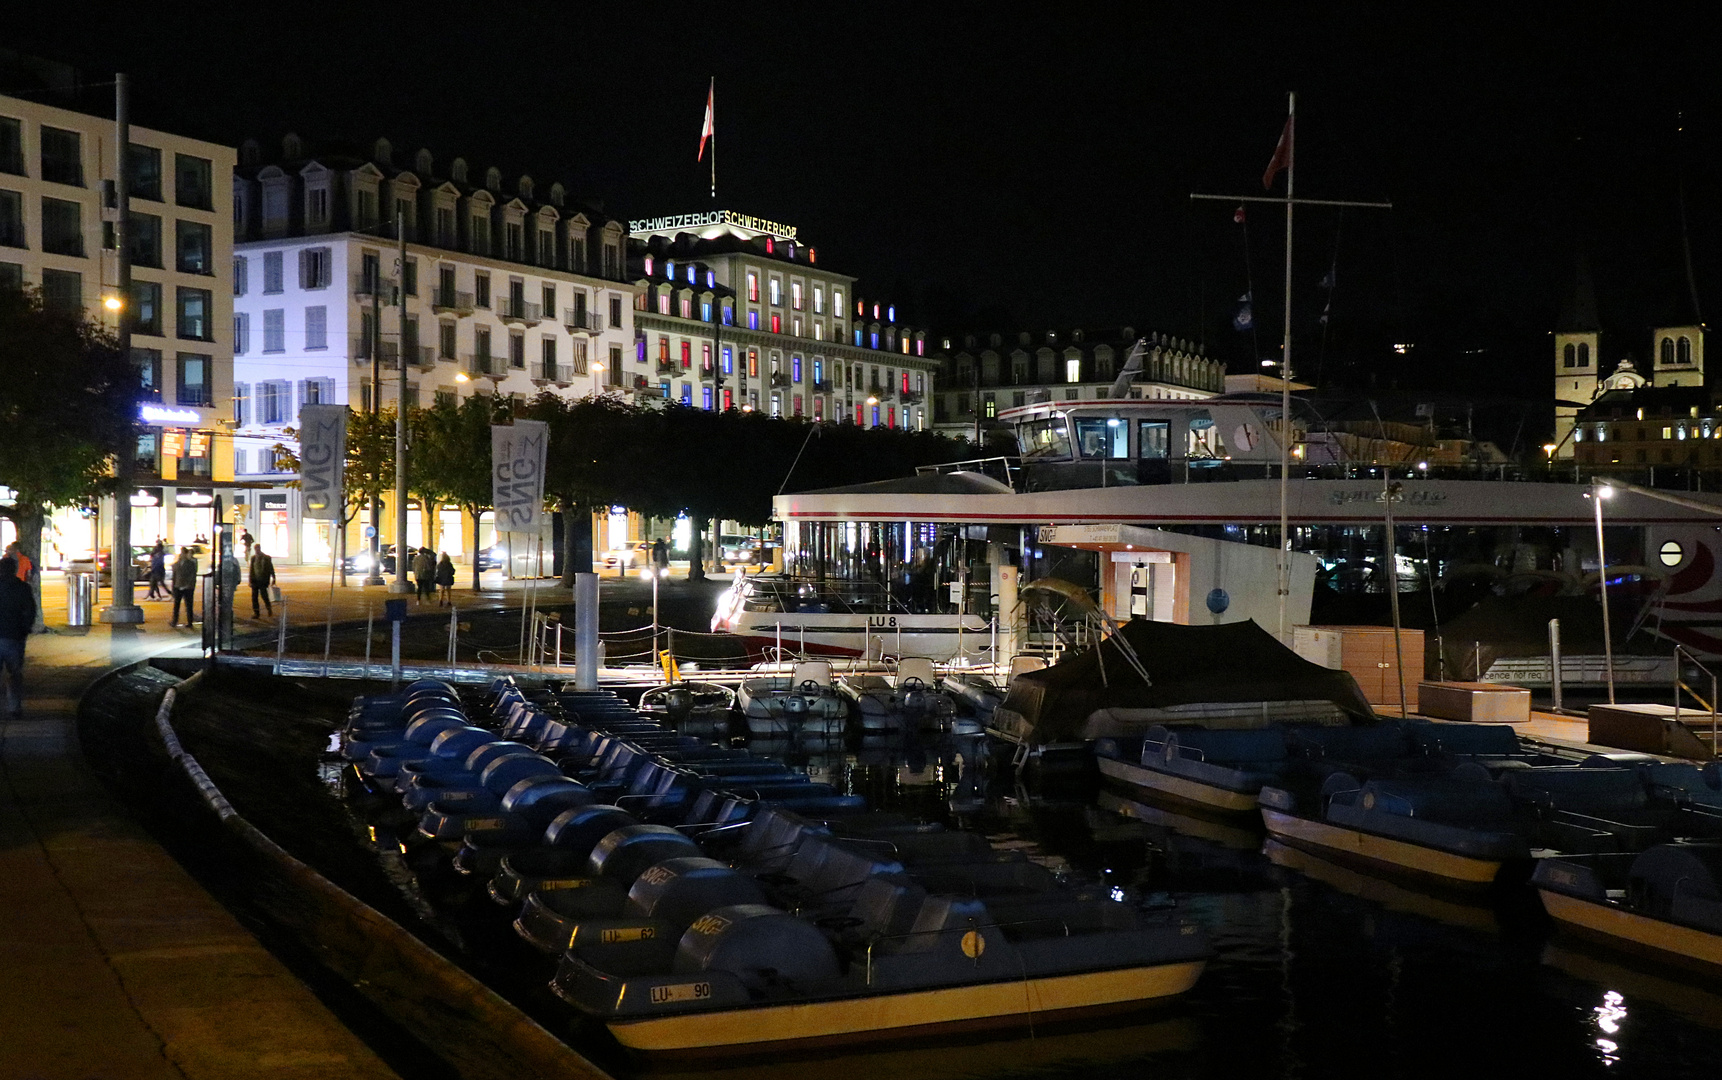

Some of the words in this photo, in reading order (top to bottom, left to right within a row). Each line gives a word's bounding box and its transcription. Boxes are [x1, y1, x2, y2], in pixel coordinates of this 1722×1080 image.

[629, 210, 725, 232] SCHWEIZERHOF
[724, 209, 797, 239] SCHWEIZERHOF
[1040, 529, 1052, 542] SNG
[869, 616, 885, 627] LU
[889, 616, 897, 627] 8
[641, 866, 667, 885] SNG
[692, 915, 720, 935] SNG
[603, 930, 618, 943] LU
[641, 928, 654, 941] 62
[652, 987, 668, 1002] LU
[694, 983, 709, 998] 90
